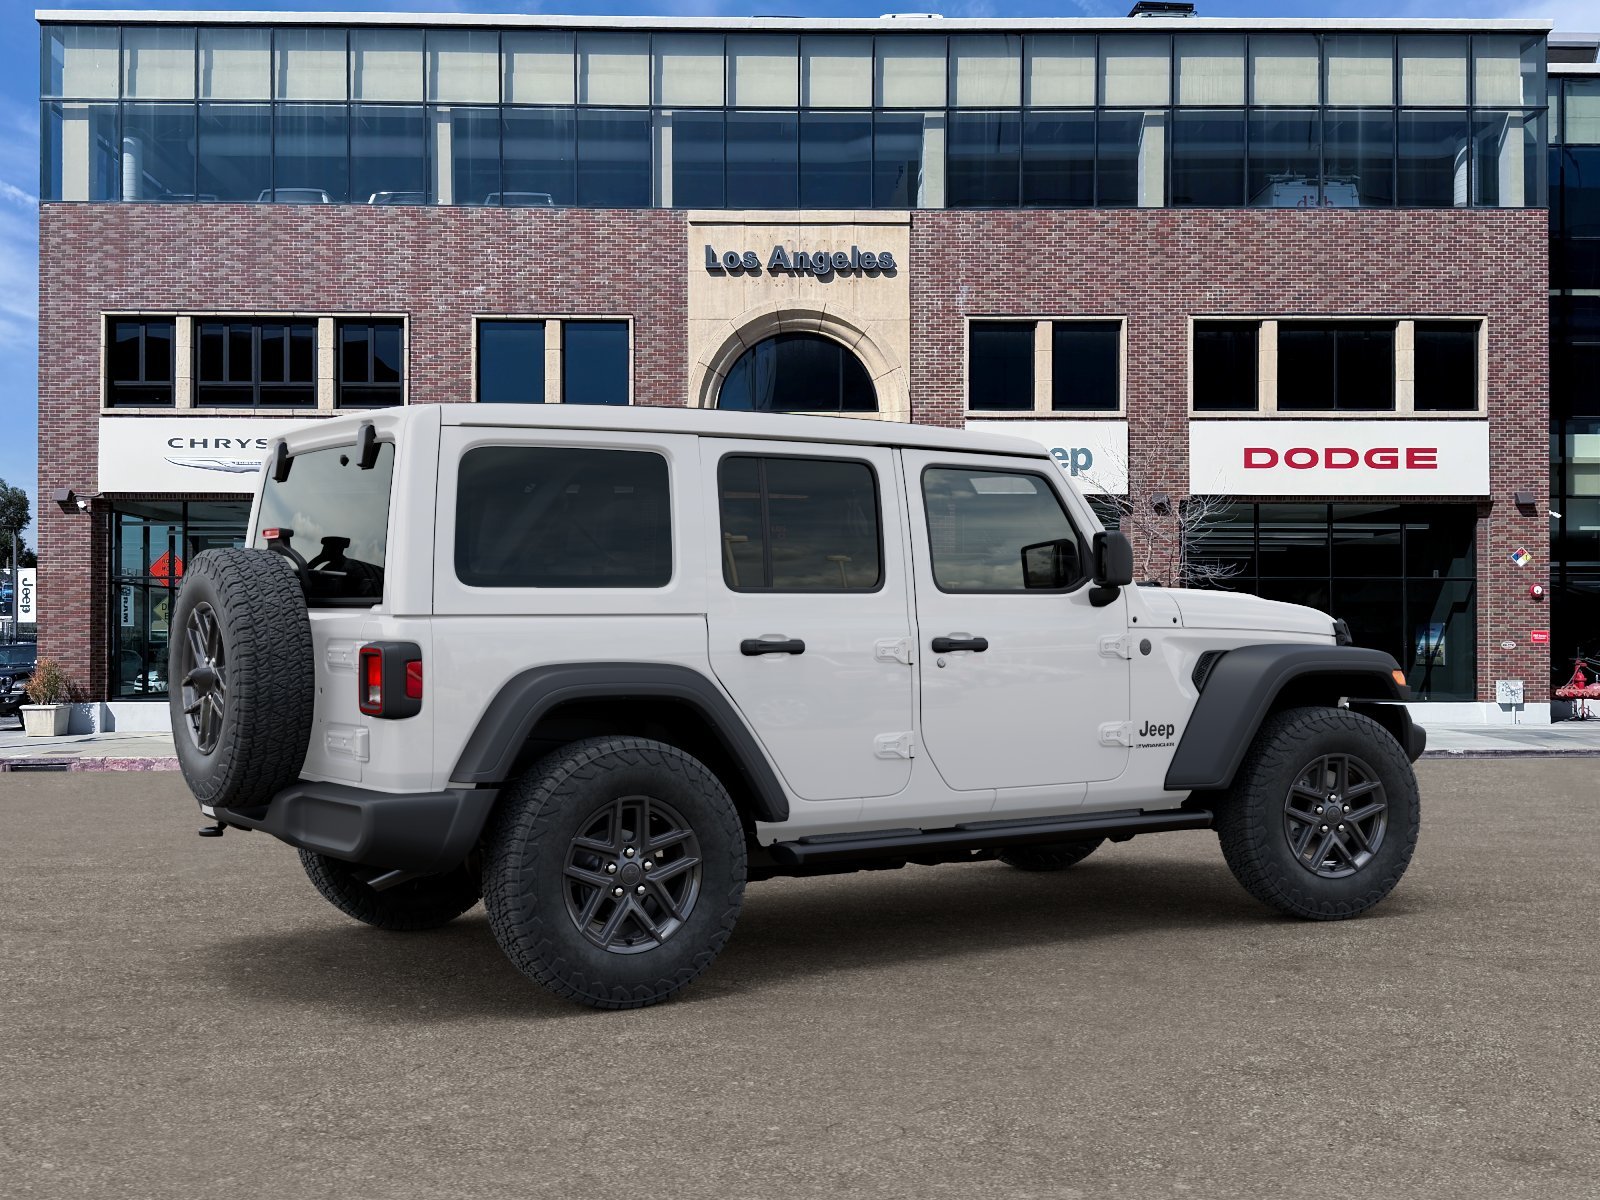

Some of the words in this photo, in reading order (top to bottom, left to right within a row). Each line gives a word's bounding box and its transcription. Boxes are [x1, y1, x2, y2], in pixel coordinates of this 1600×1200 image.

[704, 244, 758, 270] Los
[767, 244, 894, 275] Angeles
[167, 437, 268, 449] CHRYS
[1243, 447, 1438, 470] DODGE
[20, 577, 34, 613] Jeep
[1139, 720, 1175, 739] Jeep
